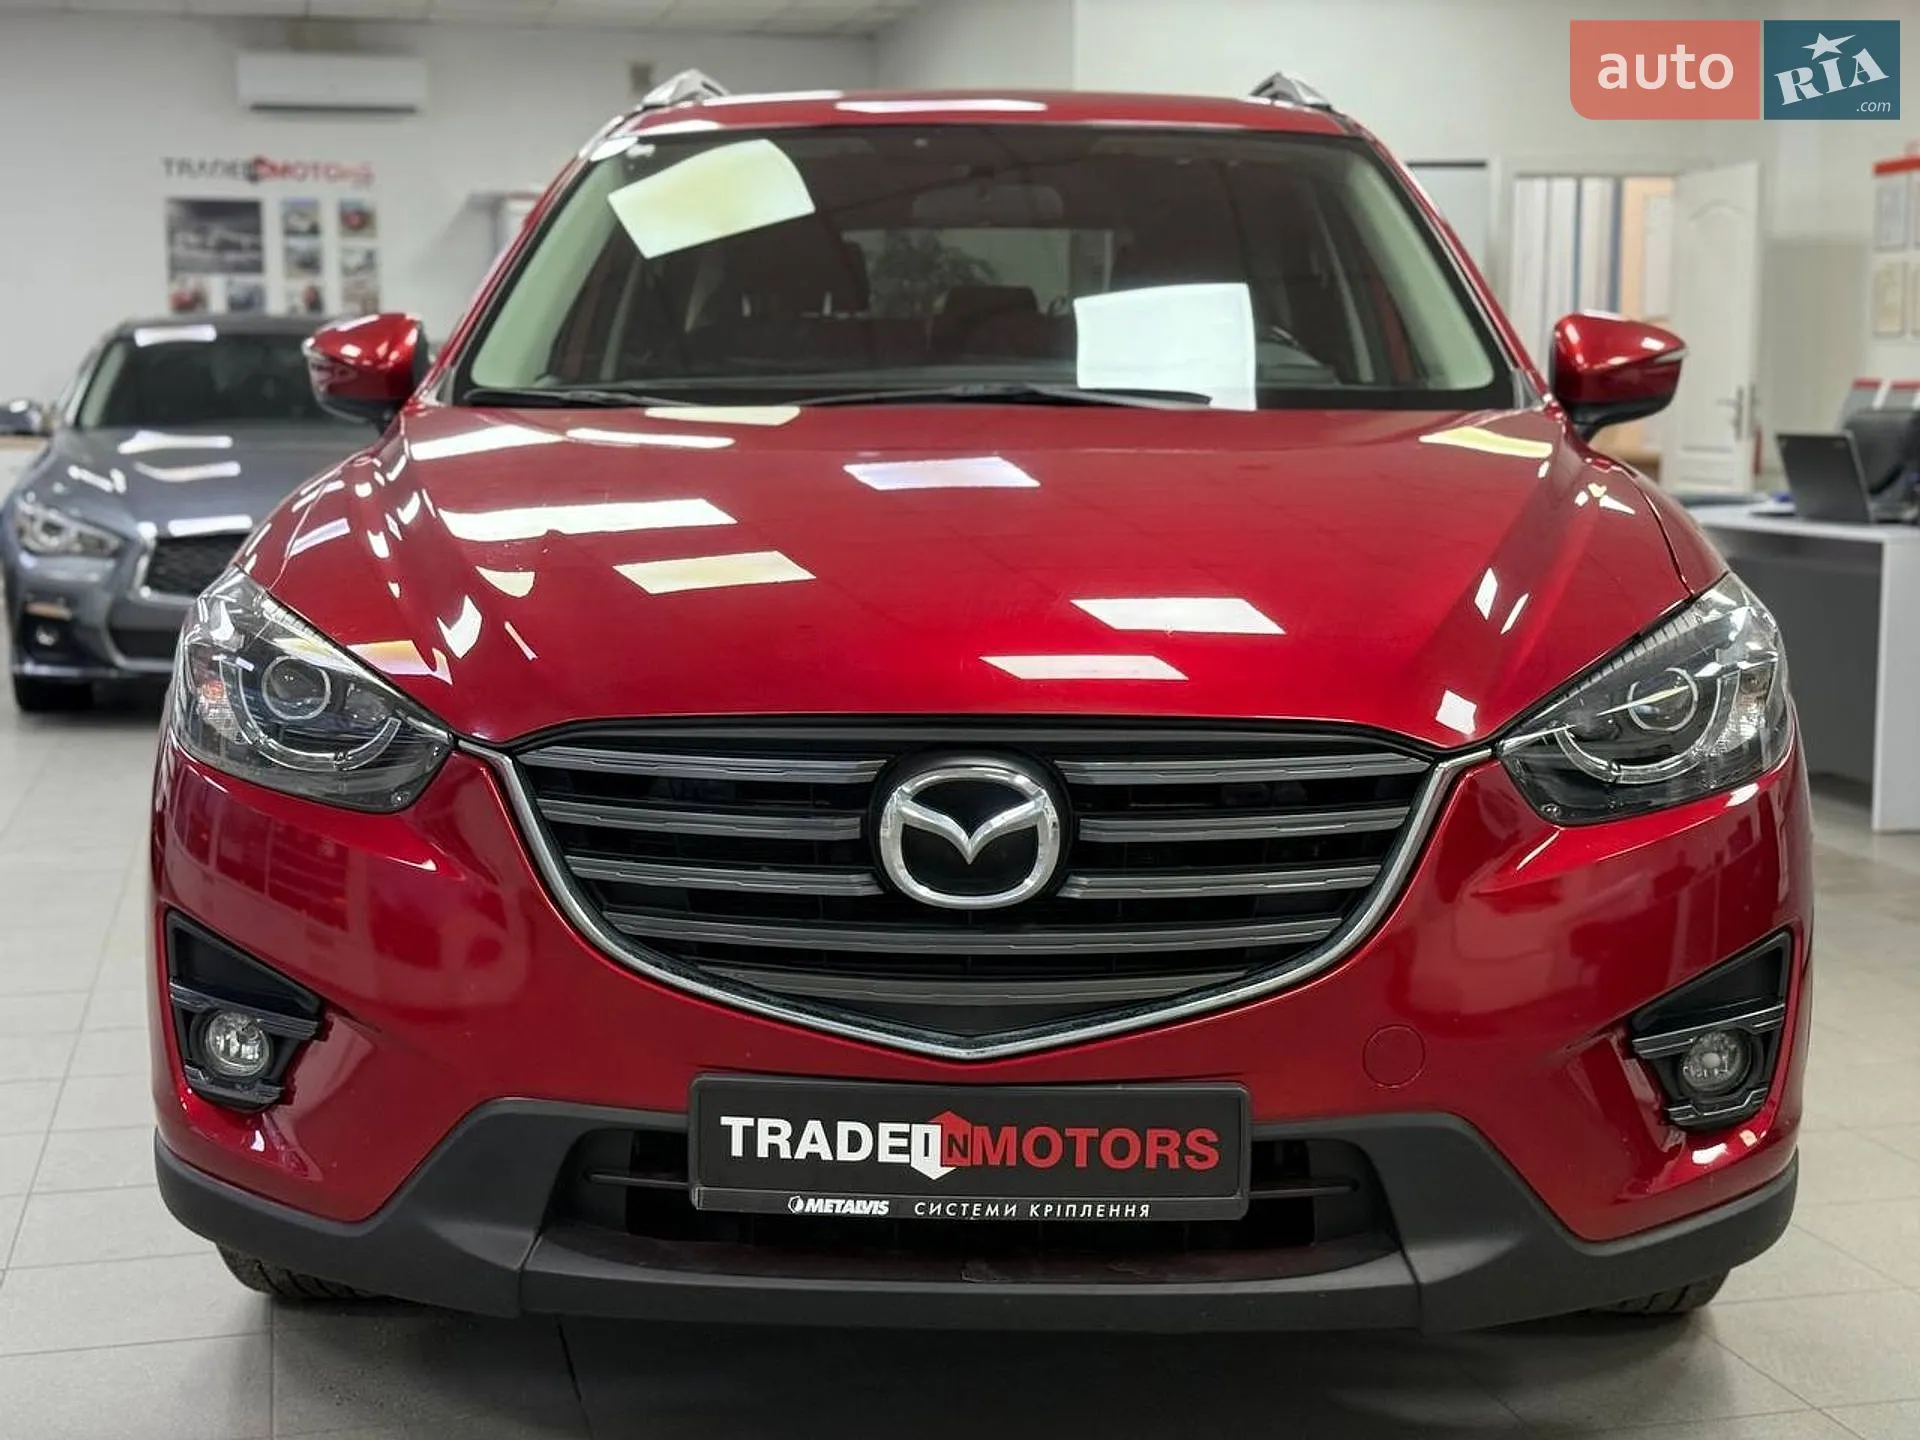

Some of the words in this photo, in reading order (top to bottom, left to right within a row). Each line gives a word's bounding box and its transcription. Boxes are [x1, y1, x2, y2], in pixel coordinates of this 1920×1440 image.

[804, 1198, 889, 1216] METALVIS
[914, 1202, 1017, 1217] СИСТЕМИ
[1029, 1204, 1150, 1218] КРІПЛЕННЯ
